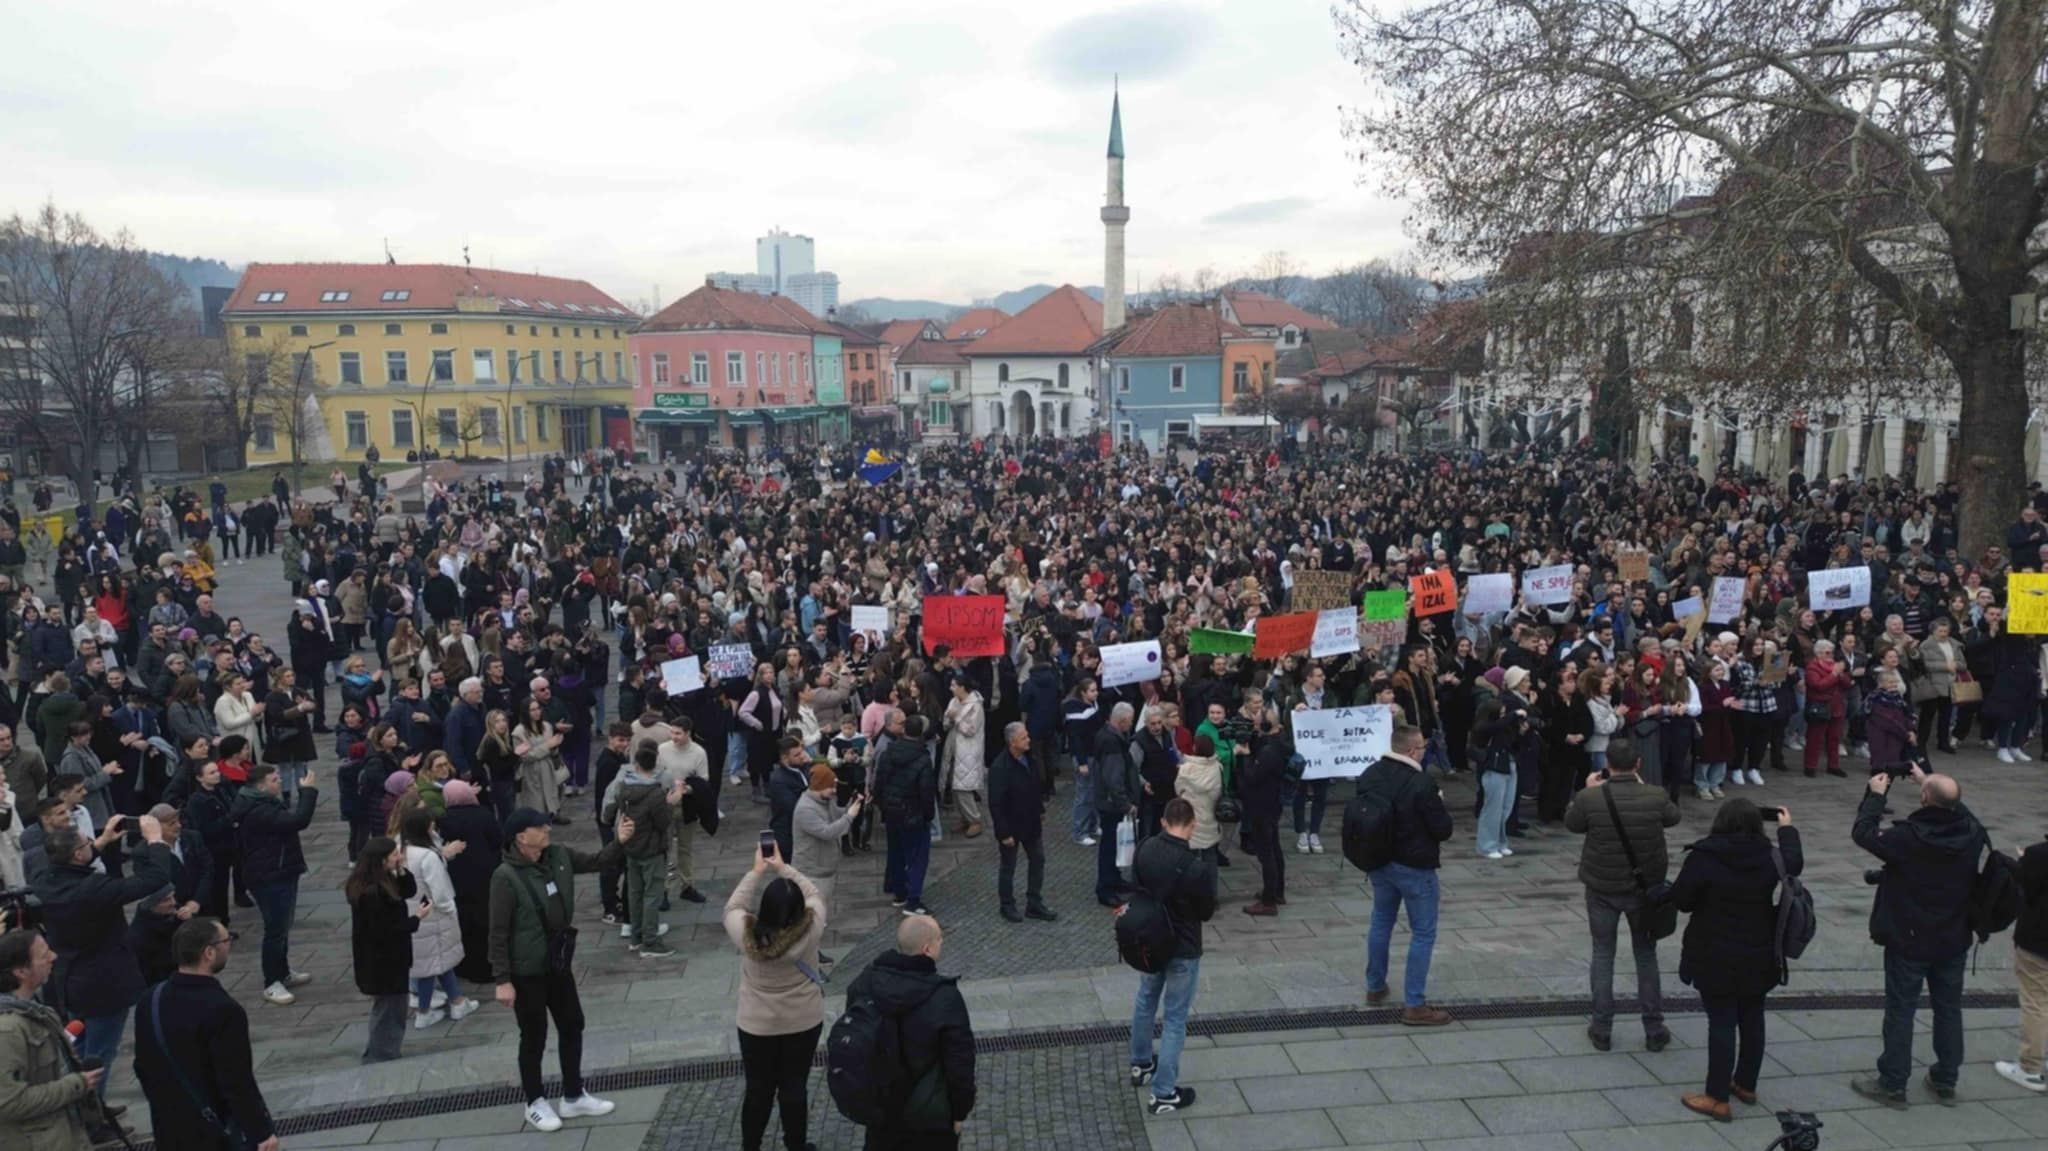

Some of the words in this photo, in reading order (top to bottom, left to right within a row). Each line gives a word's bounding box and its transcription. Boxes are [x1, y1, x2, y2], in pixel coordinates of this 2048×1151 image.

[1420, 575, 1443, 592] IMA
[1531, 578, 1545, 591] NE
[935, 604, 997, 630] GIPSOM
[1334, 709, 1354, 719] ZA
[1342, 726, 1375, 737] SUTRA
